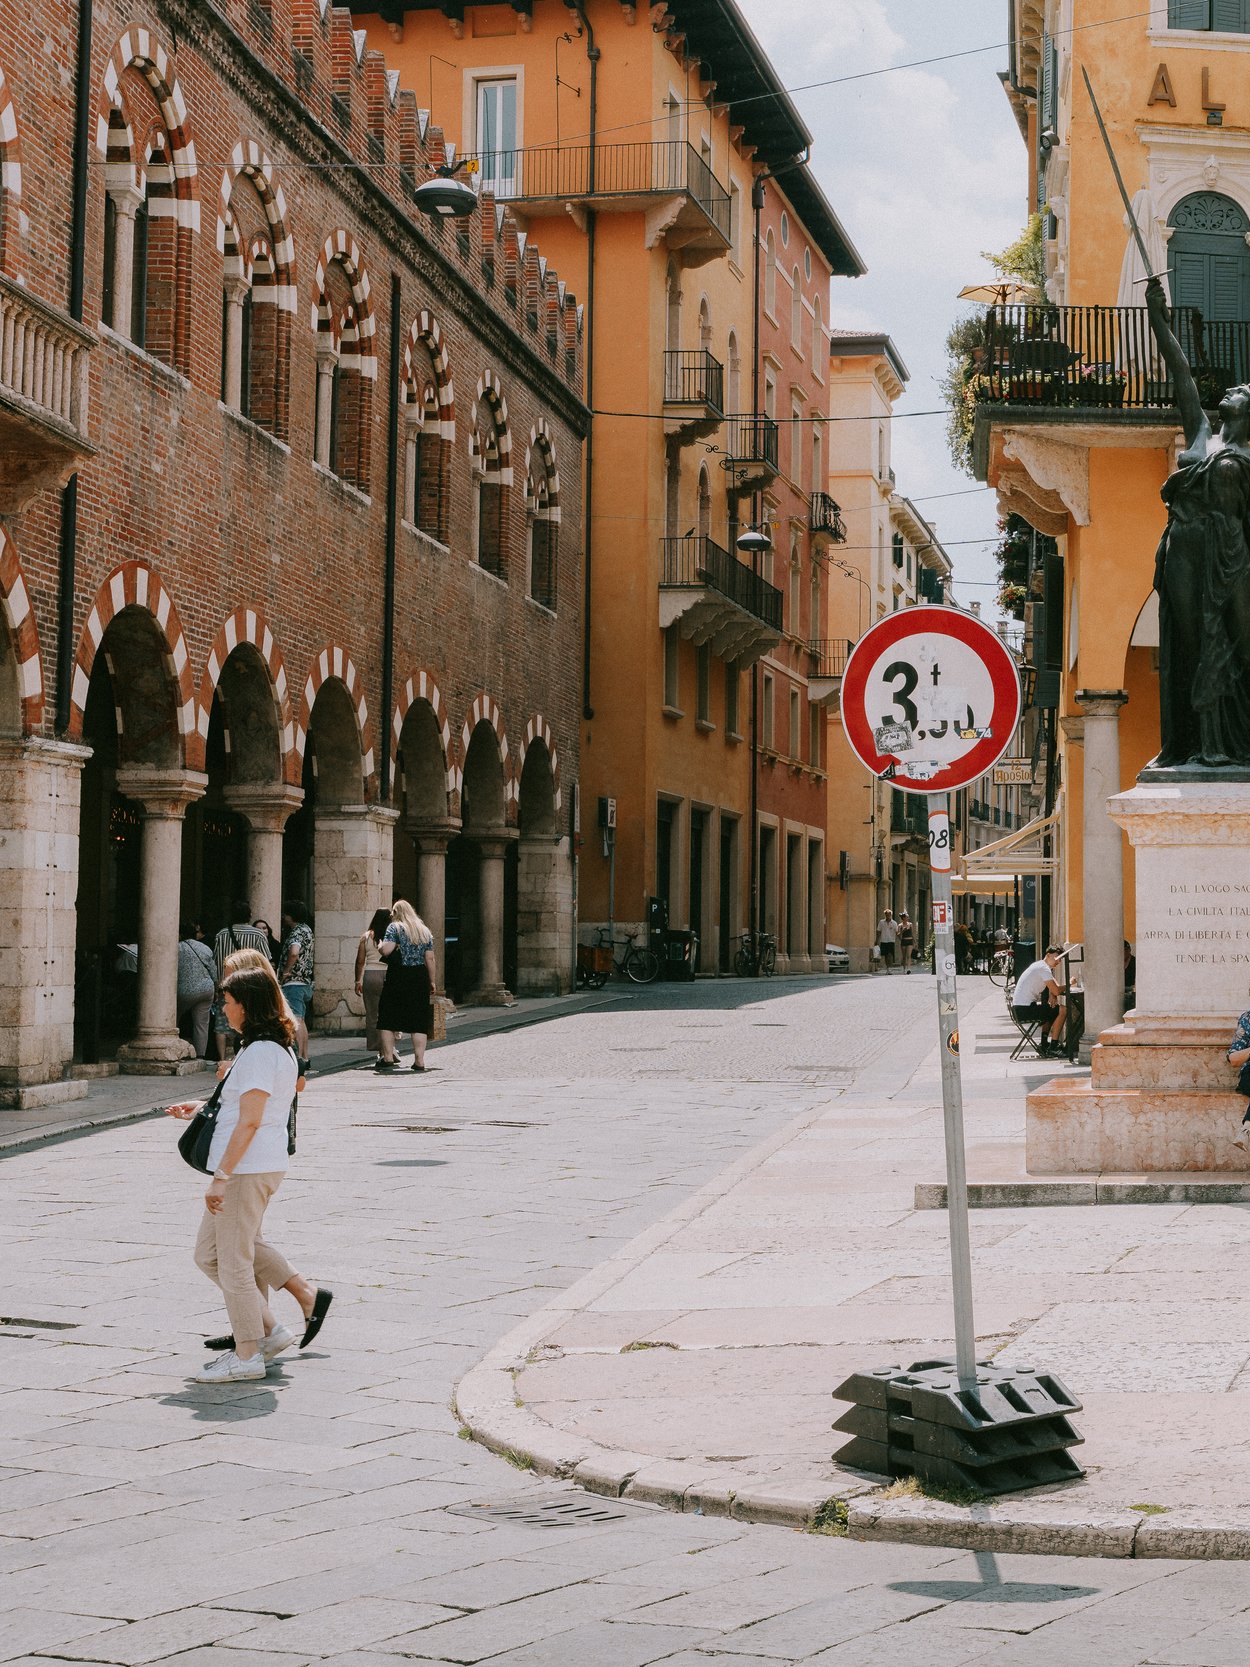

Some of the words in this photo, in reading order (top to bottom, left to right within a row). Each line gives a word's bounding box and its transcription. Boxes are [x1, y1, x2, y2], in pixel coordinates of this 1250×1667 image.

[1011, 760, 1021, 771] 12
[1170, 885, 1190, 894] DAL
[1195, 885, 1231, 894] LVOGO
[651, 904, 658, 912] P
[1168, 907, 1183, 917] LA
[1175, 930, 1185, 940] DI
[1235, 930, 1242, 940] E
[1176, 954, 1208, 964] TENDE
[1212, 954, 1226, 964] LA
